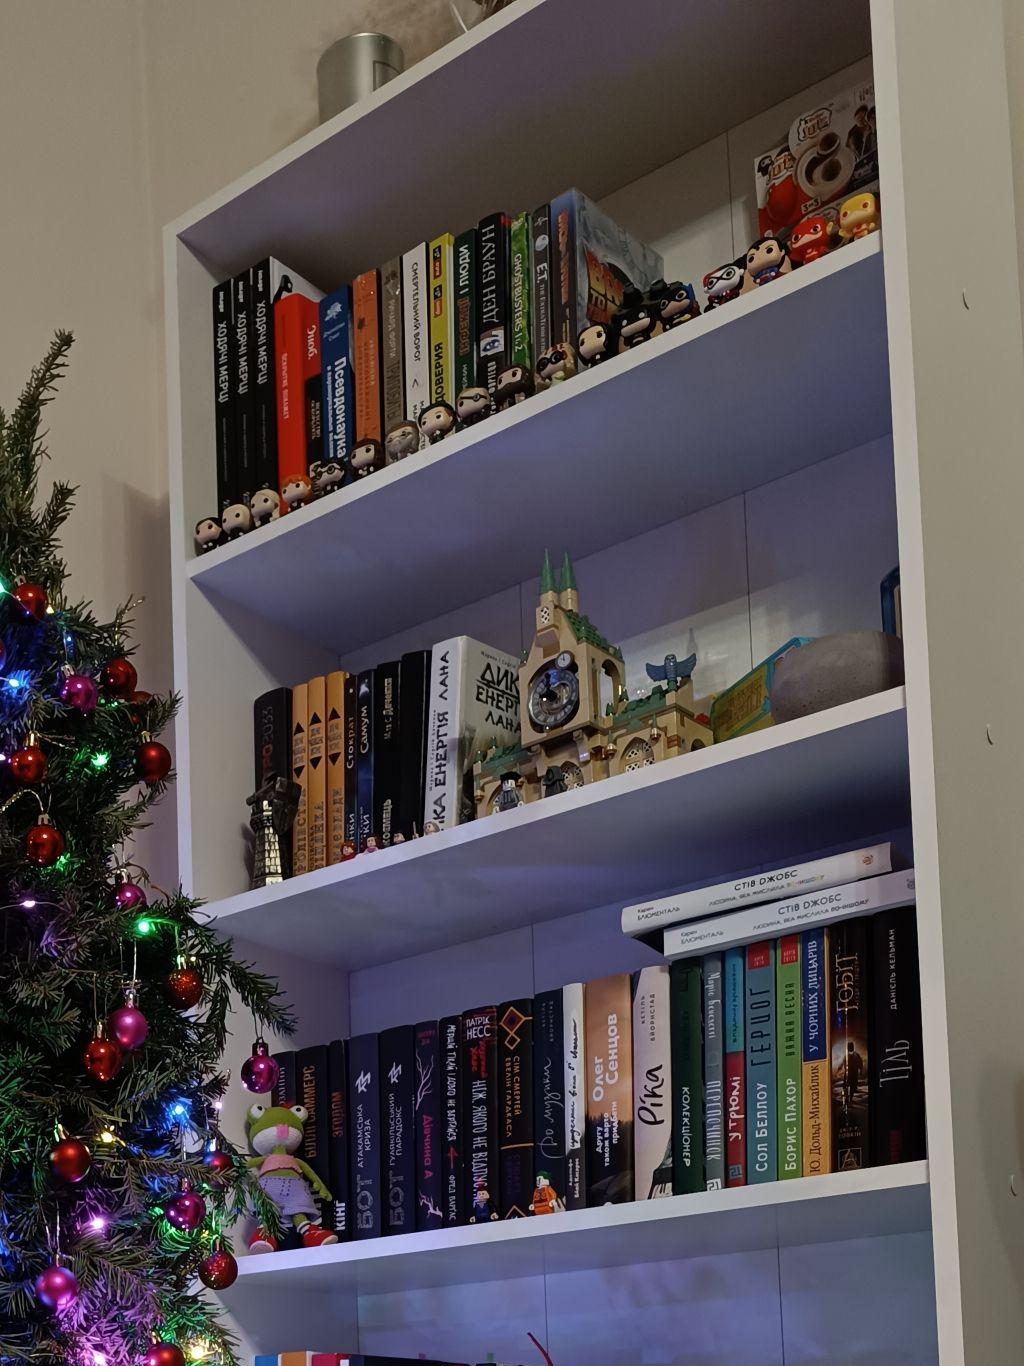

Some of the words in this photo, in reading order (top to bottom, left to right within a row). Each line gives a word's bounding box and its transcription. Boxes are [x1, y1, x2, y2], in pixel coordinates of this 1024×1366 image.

[459, 244, 470, 286] ЛЮДИ
[482, 224, 498, 282] БРАУН
[412, 262, 420, 331] СМЕРТЕЛЬНИЙ
[482, 285, 499, 323] ДЕН
[515, 254, 524, 332] GHOSTBUSTERS
[217, 321, 228, 361] ХОДЯЧІ
[237, 311, 248, 355] ХОДЯЧІ
[257, 300, 267, 345] ХОДЯЧІ
[257, 347, 268, 385] МЕРЦІ
[412, 332, 420, 362] ВОРОГ
[218, 364, 229, 403] МЕРЦІ
[238, 357, 249, 394] МЕРЦІ
[332, 356, 346, 459] Псевдонаука
[438, 651, 450, 700] ЛАНА
[347, 716, 356, 768] Стократ
[359, 705, 370, 754] Самум
[434, 711, 449, 787] ЕНЕРГІЯ
[734, 878, 756, 892] СТІВ
[759, 869, 799, 887] ДЖОБС
[778, 903, 801, 916] СТІВ
[804, 893, 843, 910] ДЖОБС
[807, 940, 820, 989] ЛИЦАРІВ
[888, 929, 897, 970] КЕЛЬМАН
[466, 1025, 492, 1041] НЕСС
[749, 988, 772, 1067] ГЕРЦОГ
[808, 992, 819, 1039] ЧОРНИХ
[606, 1014, 620, 1084] Сенцов
[809, 1044, 818, 1053] У
[514, 1076, 522, 1116] СМЕРТЕЙ
[592, 1056, 605, 1102] Олег
[637, 1064, 665, 1126] Ріка
[785, 1079, 797, 1122] ПАХОР
[331, 1092, 344, 1139] ЗГОДОМ
[395, 1105, 403, 1155] ПАРАДОКС
[471, 1105, 488, 1133] ЯКОГО
[603, 1113, 612, 1137] варто
[610, 1102, 620, 1144] придбати
[681, 1087, 691, 1167] КОЛЕКЦІОНЕР
[706, 1080, 722, 1160] ПЕРЕПОЧИНОК
[756, 1083, 768, 1139] БЕЛЛОУ
[808, 1066, 822, 1156] Дольд-Михайлик
[356, 1104, 365, 1168] АТАКАМСЬКА
[364, 1118, 372, 1151] КРИЗА
[423, 1114, 434, 1167] Дівчина
[473, 1137, 488, 1150] НЕ
[595, 1127, 604, 1153] Другу
[786, 1128, 797, 1171] БОРИС
[756, 1144, 768, 1172] СОЛ
[334, 1200, 347, 1231] КІНГ
[356, 1175, 374, 1229] БОТ
[388, 1170, 405, 1226] БОТ
